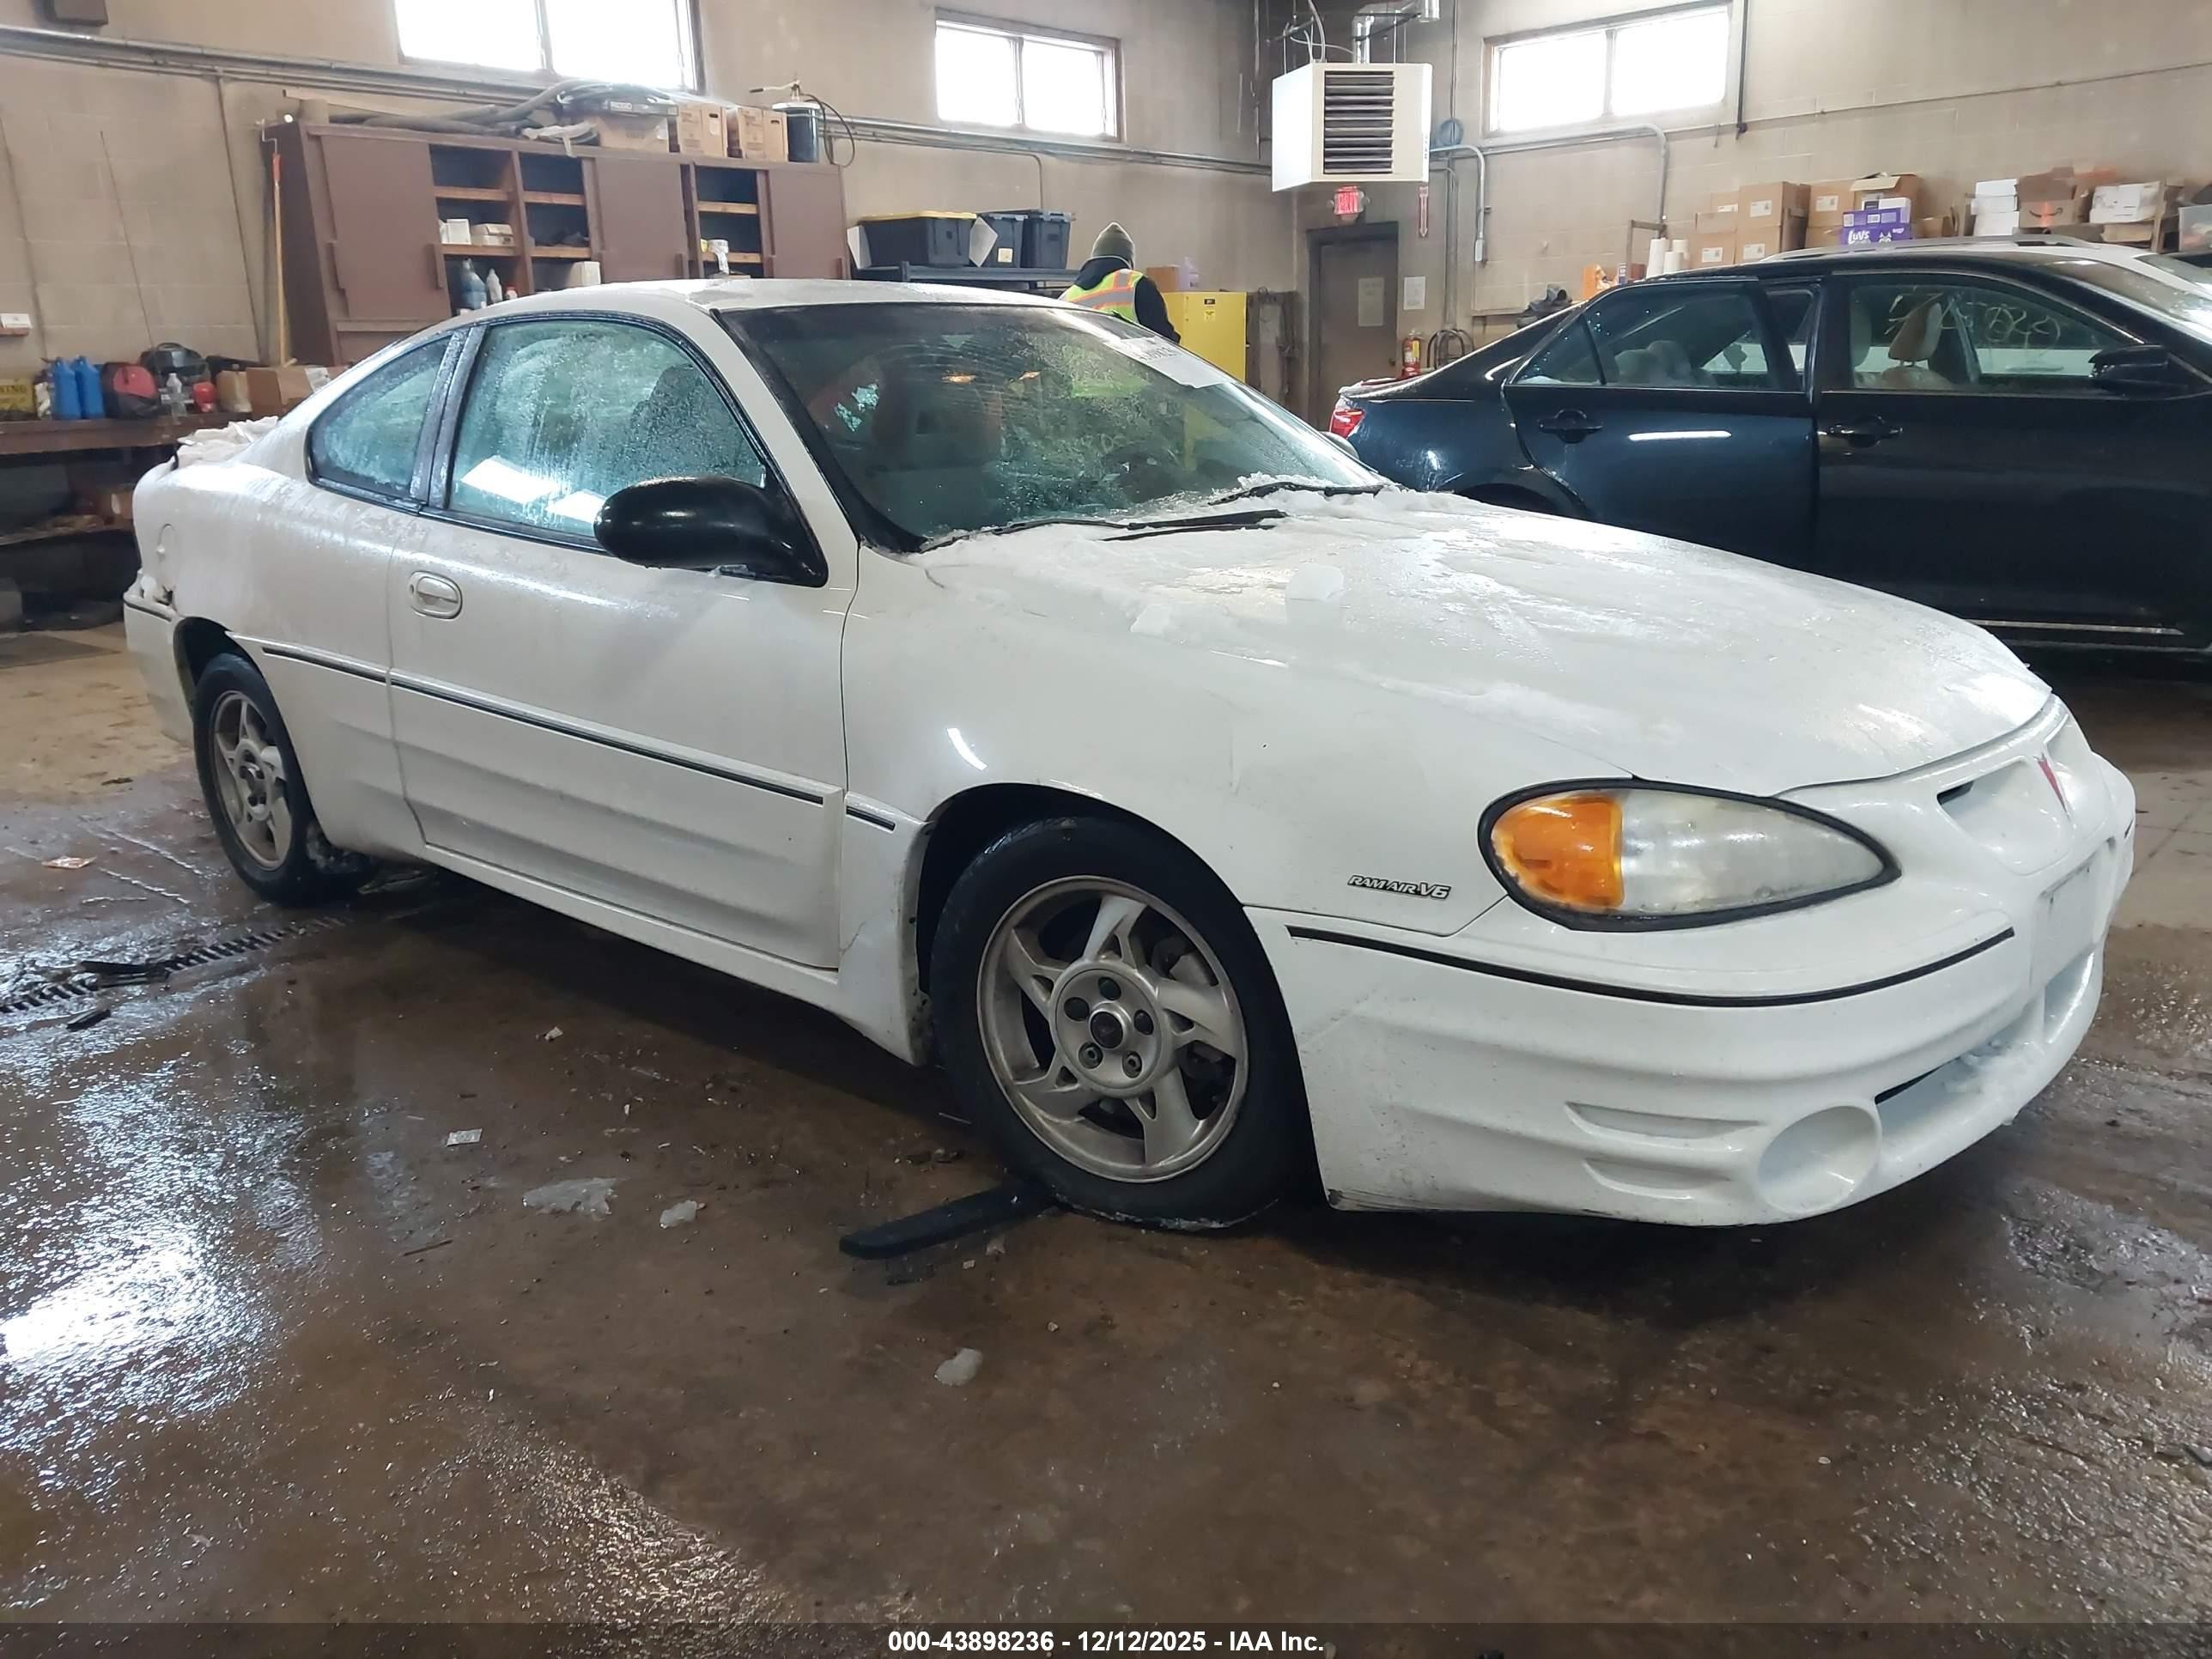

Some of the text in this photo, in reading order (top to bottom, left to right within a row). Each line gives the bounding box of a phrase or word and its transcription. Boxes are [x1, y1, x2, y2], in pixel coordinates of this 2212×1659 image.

[1347, 875, 1451, 899] RAM AIR V6
